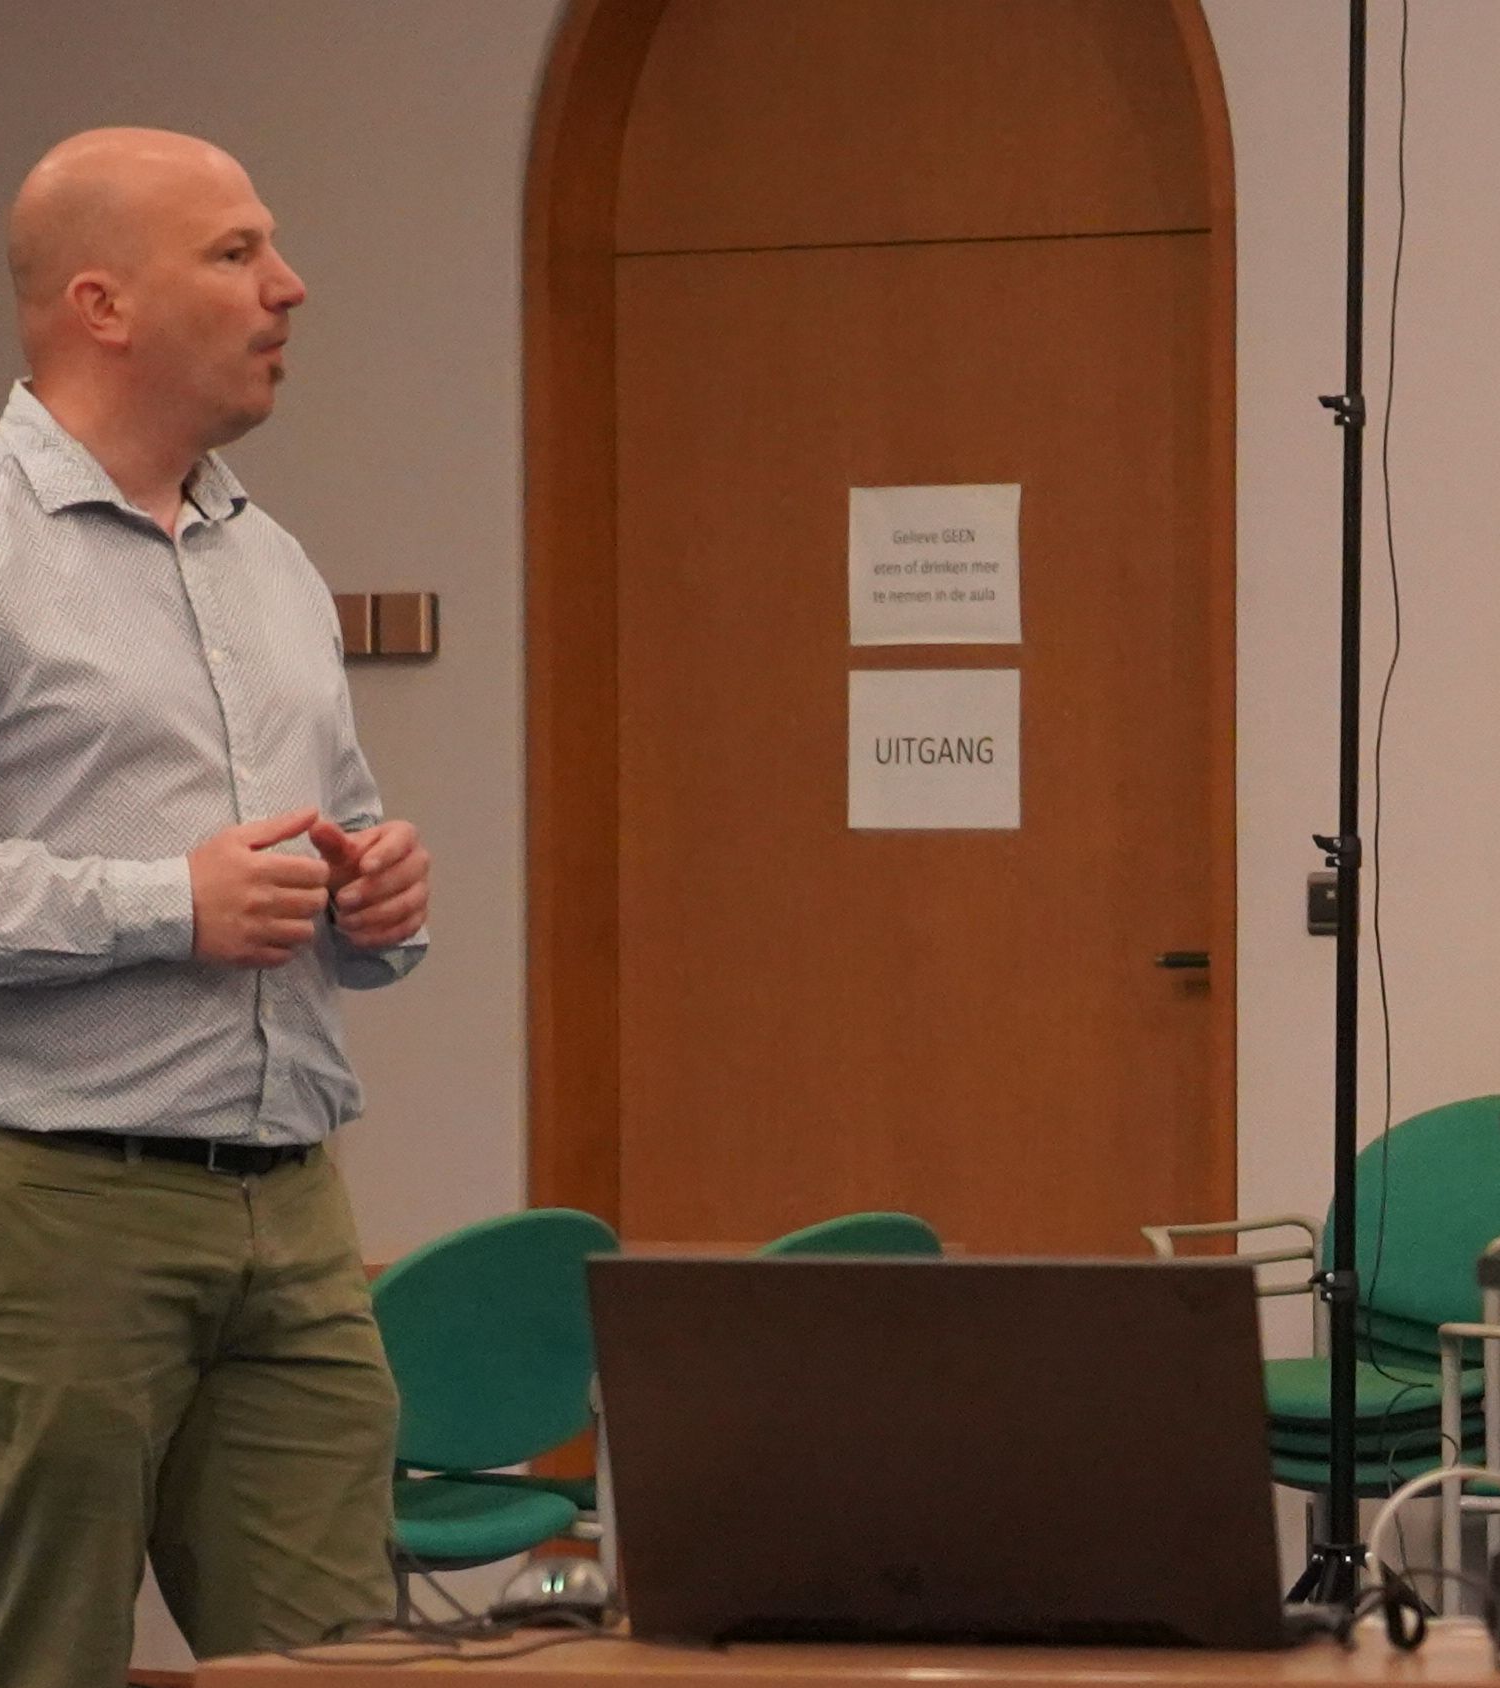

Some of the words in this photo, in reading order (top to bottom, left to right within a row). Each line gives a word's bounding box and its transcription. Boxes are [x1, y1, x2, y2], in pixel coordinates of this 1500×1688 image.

[941, 528, 976, 543] GEEN
[873, 563, 902, 575] eten
[904, 560, 918, 575] of
[920, 560, 968, 575] drinken
[970, 561, 1000, 574] mee
[949, 587, 966, 601] de
[969, 587, 996, 602] aula
[875, 736, 994, 765] UITGANG
